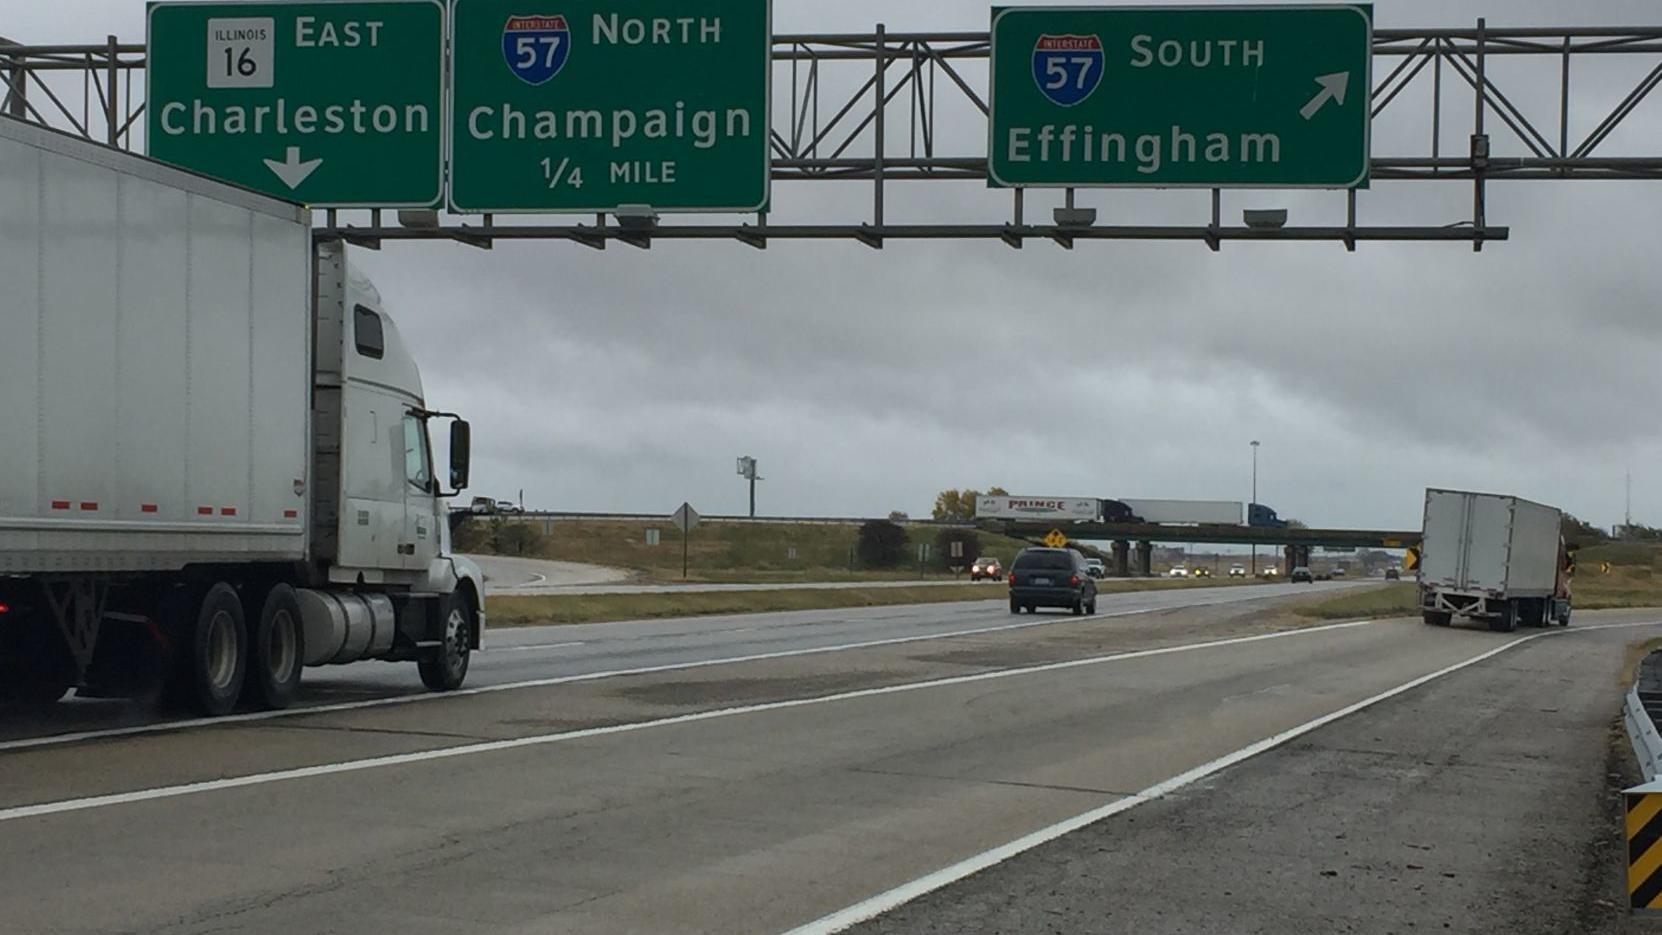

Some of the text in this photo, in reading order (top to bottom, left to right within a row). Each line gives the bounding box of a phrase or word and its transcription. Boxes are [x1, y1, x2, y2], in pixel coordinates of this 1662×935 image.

[215, 29, 267, 41] ILLINOIS
[295, 16, 384, 47] EAST
[512, 20, 560, 30] INTERSTATE
[592, 13, 721, 45] NORTH
[516, 37, 560, 69] 57
[1043, 39, 1094, 49] INTERSTATE
[1130, 34, 1264, 67] SOUTH
[224, 47, 257, 77] 16
[1046, 57, 1093, 89] 57
[160, 99, 428, 134] Charleston
[468, 101, 750, 149] Champaign
[1008, 124, 1280, 174] Effingham
[610, 161, 676, 183] MILE
[1008, 499, 1065, 510] PRINCE
